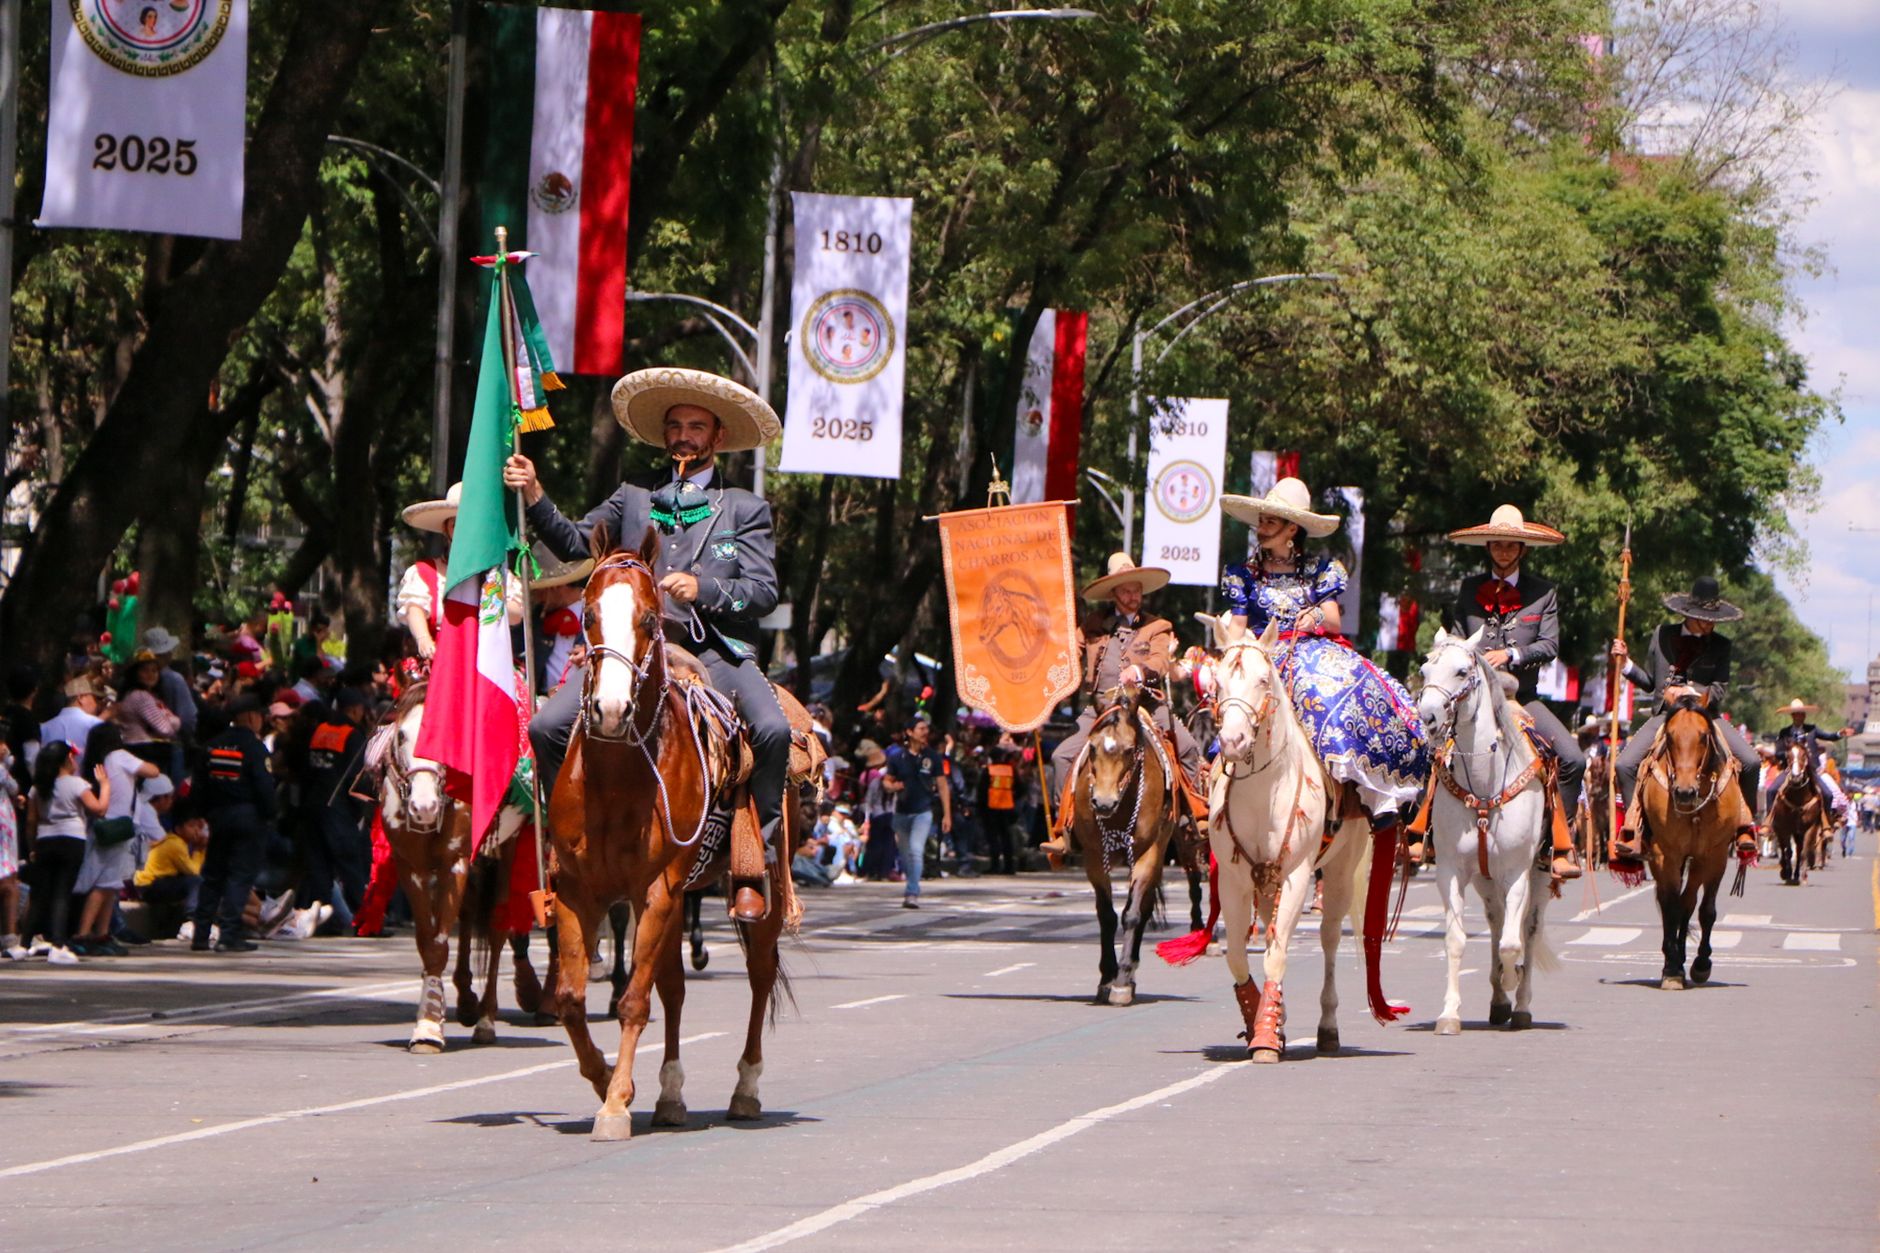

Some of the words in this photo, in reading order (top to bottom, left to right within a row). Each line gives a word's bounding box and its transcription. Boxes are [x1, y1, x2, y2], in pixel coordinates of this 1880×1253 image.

[92, 133, 198, 176] 2025
[821, 230, 883, 254] 1810
[812, 417, 874, 442] 2025
[1165, 421, 1208, 437] 810
[955, 531, 1034, 553] NACIONAL
[957, 550, 1030, 570] CHARROS
[1161, 545, 1201, 562] 2025
